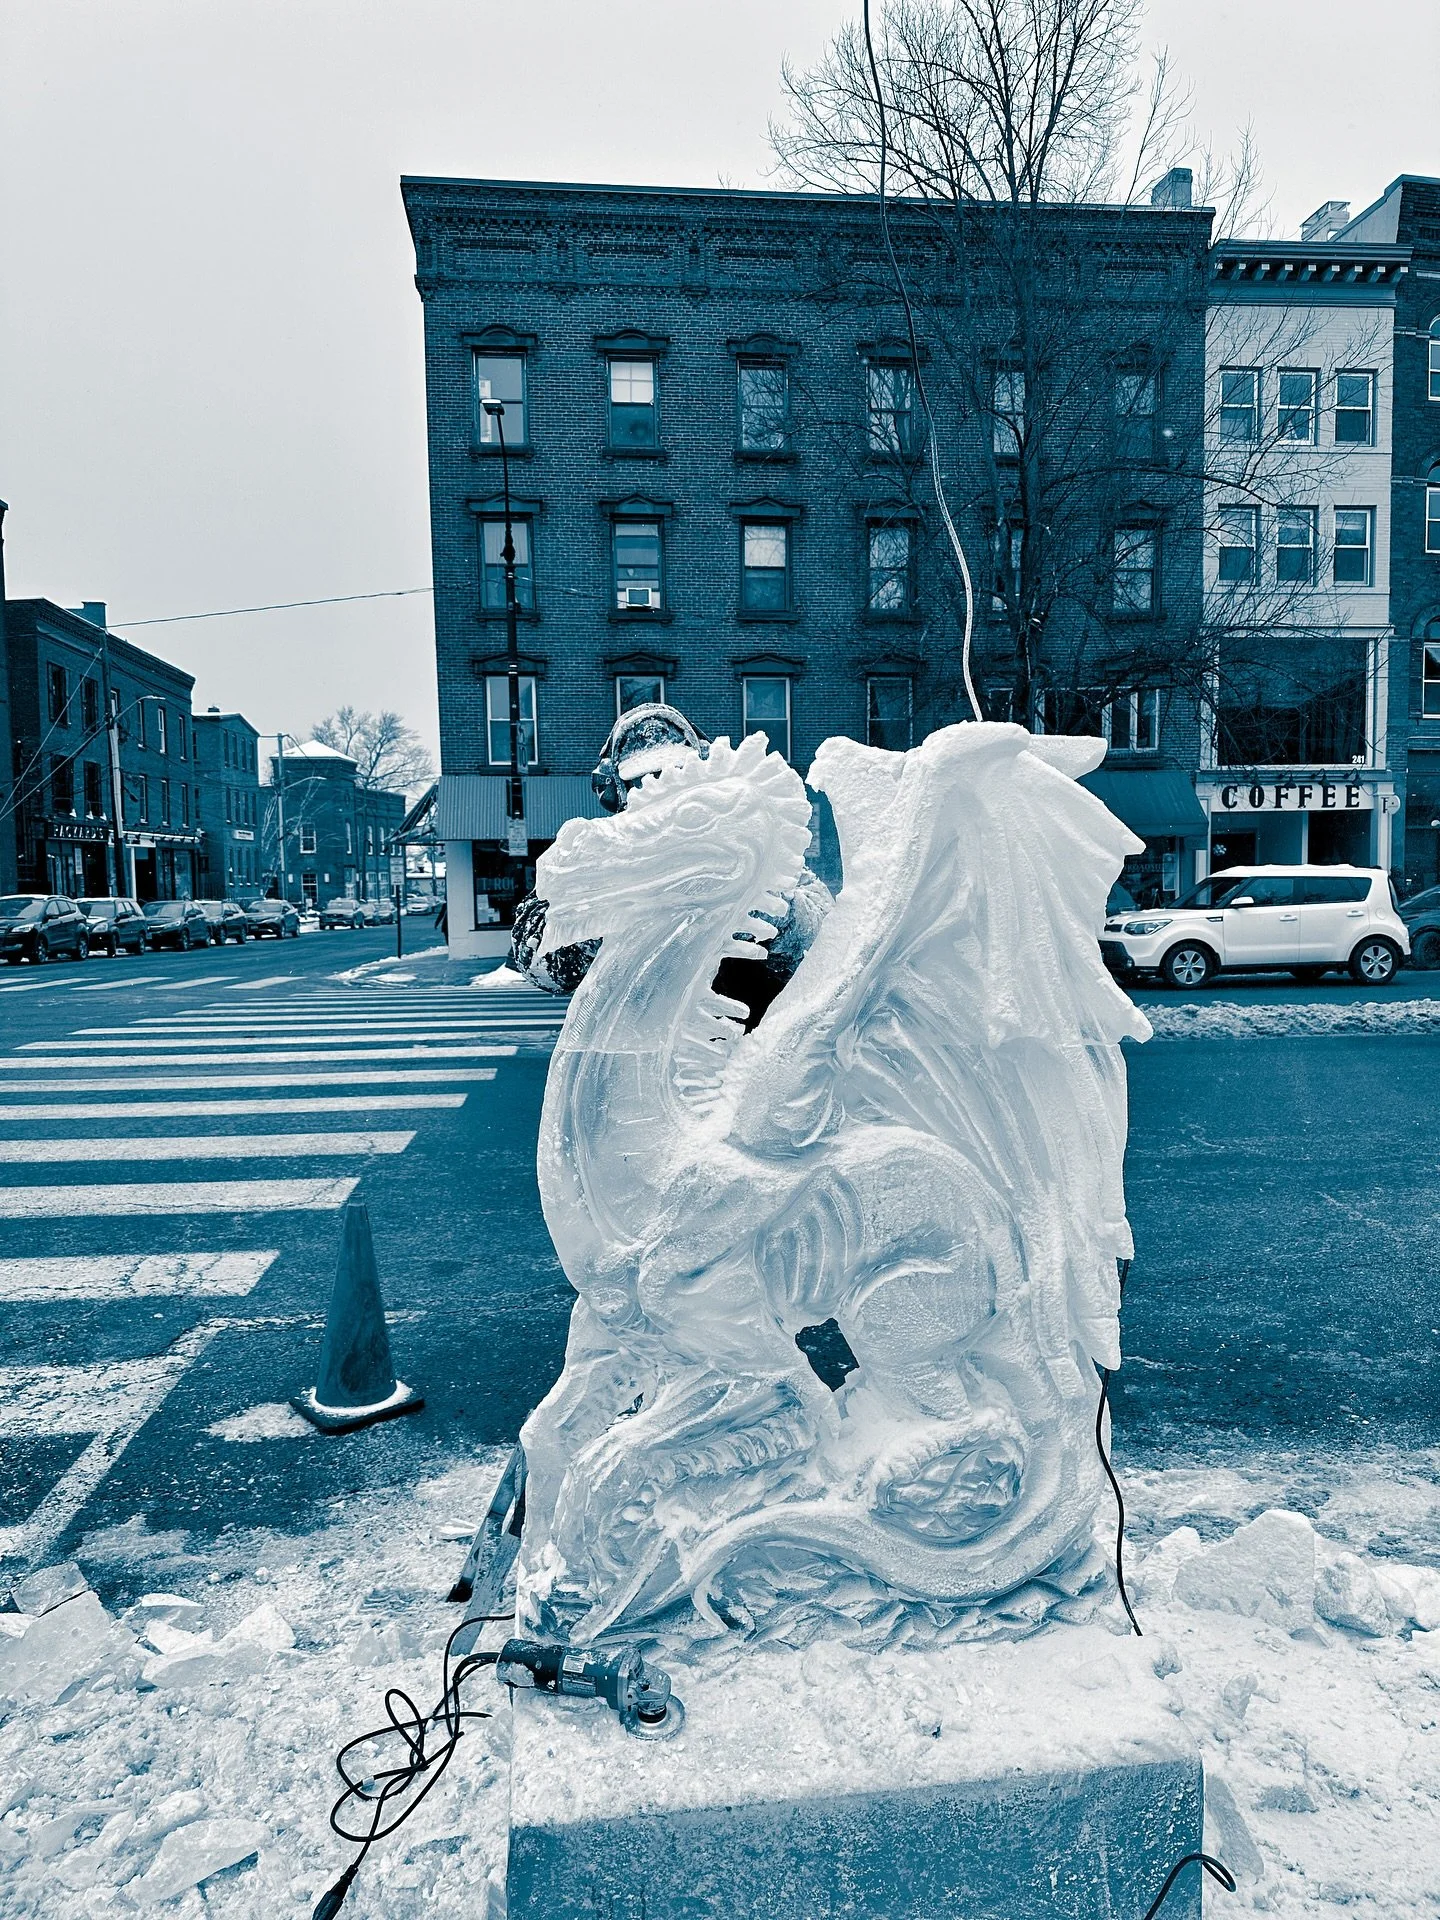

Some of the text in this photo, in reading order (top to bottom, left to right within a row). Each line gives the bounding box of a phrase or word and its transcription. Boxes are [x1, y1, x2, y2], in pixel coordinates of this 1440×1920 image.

[1352, 754, 1365, 764] 241
[1221, 784, 1361, 809] COFFEE
[53, 824, 104, 839] PACKARD'S
